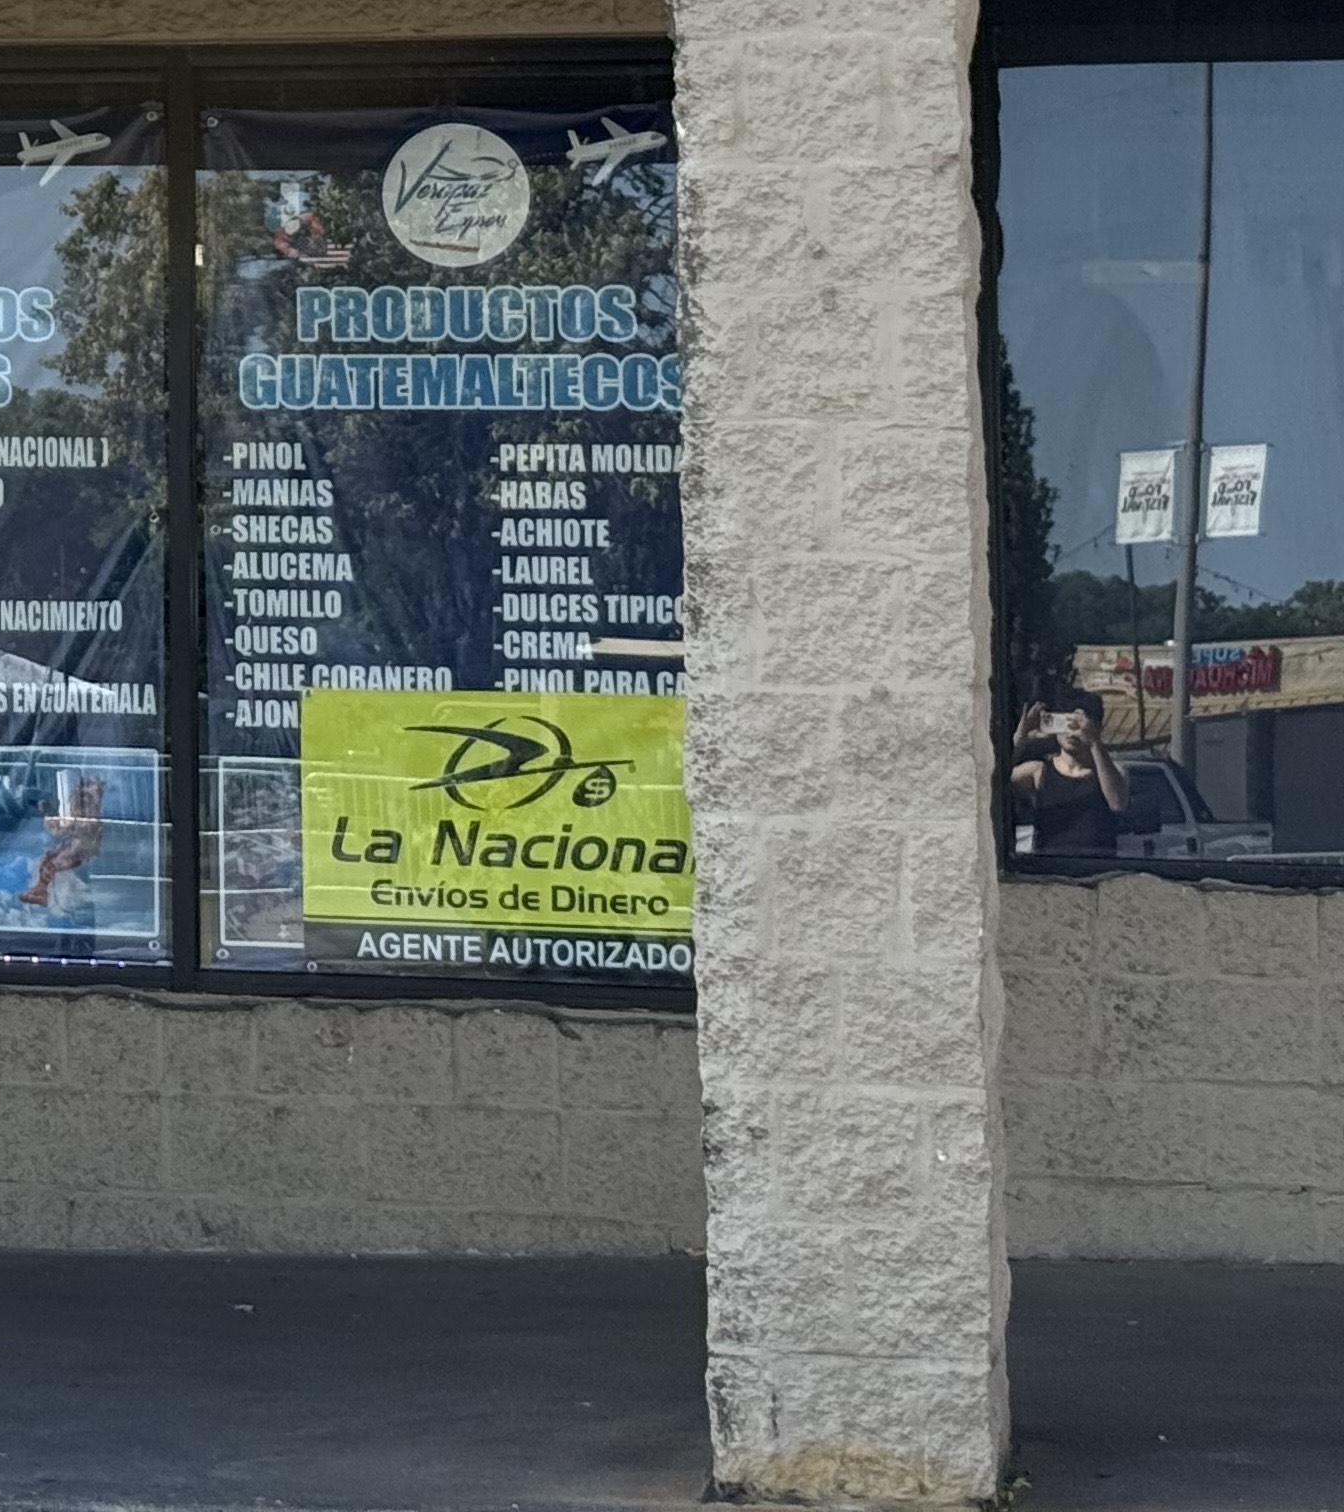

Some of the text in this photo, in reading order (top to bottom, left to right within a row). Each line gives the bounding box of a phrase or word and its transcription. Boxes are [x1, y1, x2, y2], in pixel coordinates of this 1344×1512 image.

[296, 285, 638, 343] PRODUCTOS
[223, 442, 306, 471] -PINOL
[490, 444, 586, 473] -PEPITA
[223, 479, 333, 508] -MANIAS
[490, 482, 587, 510] -HABAS
[491, 519, 609, 548] -ACHIOTE
[223, 552, 354, 581] -ALUCEMA
[492, 556, 593, 585] -LAUREL
[0, 600, 123, 631] NACIMIENTO
[224, 589, 342, 619] -TOMILLO
[493, 594, 599, 623] -DULCES
[224, 625, 318, 656] -QUESO
[493, 631, 593, 661] -CREMA
[585, 669, 650, 696] PARA
[12, 683, 36, 713] EN
[40, 683, 157, 715] GUATEMALA
[331, 816, 696, 874] La Naciona
[371, 878, 669, 916] Envíos de Dinero
[357, 931, 691, 969] AGENTE AUTORIZADO
